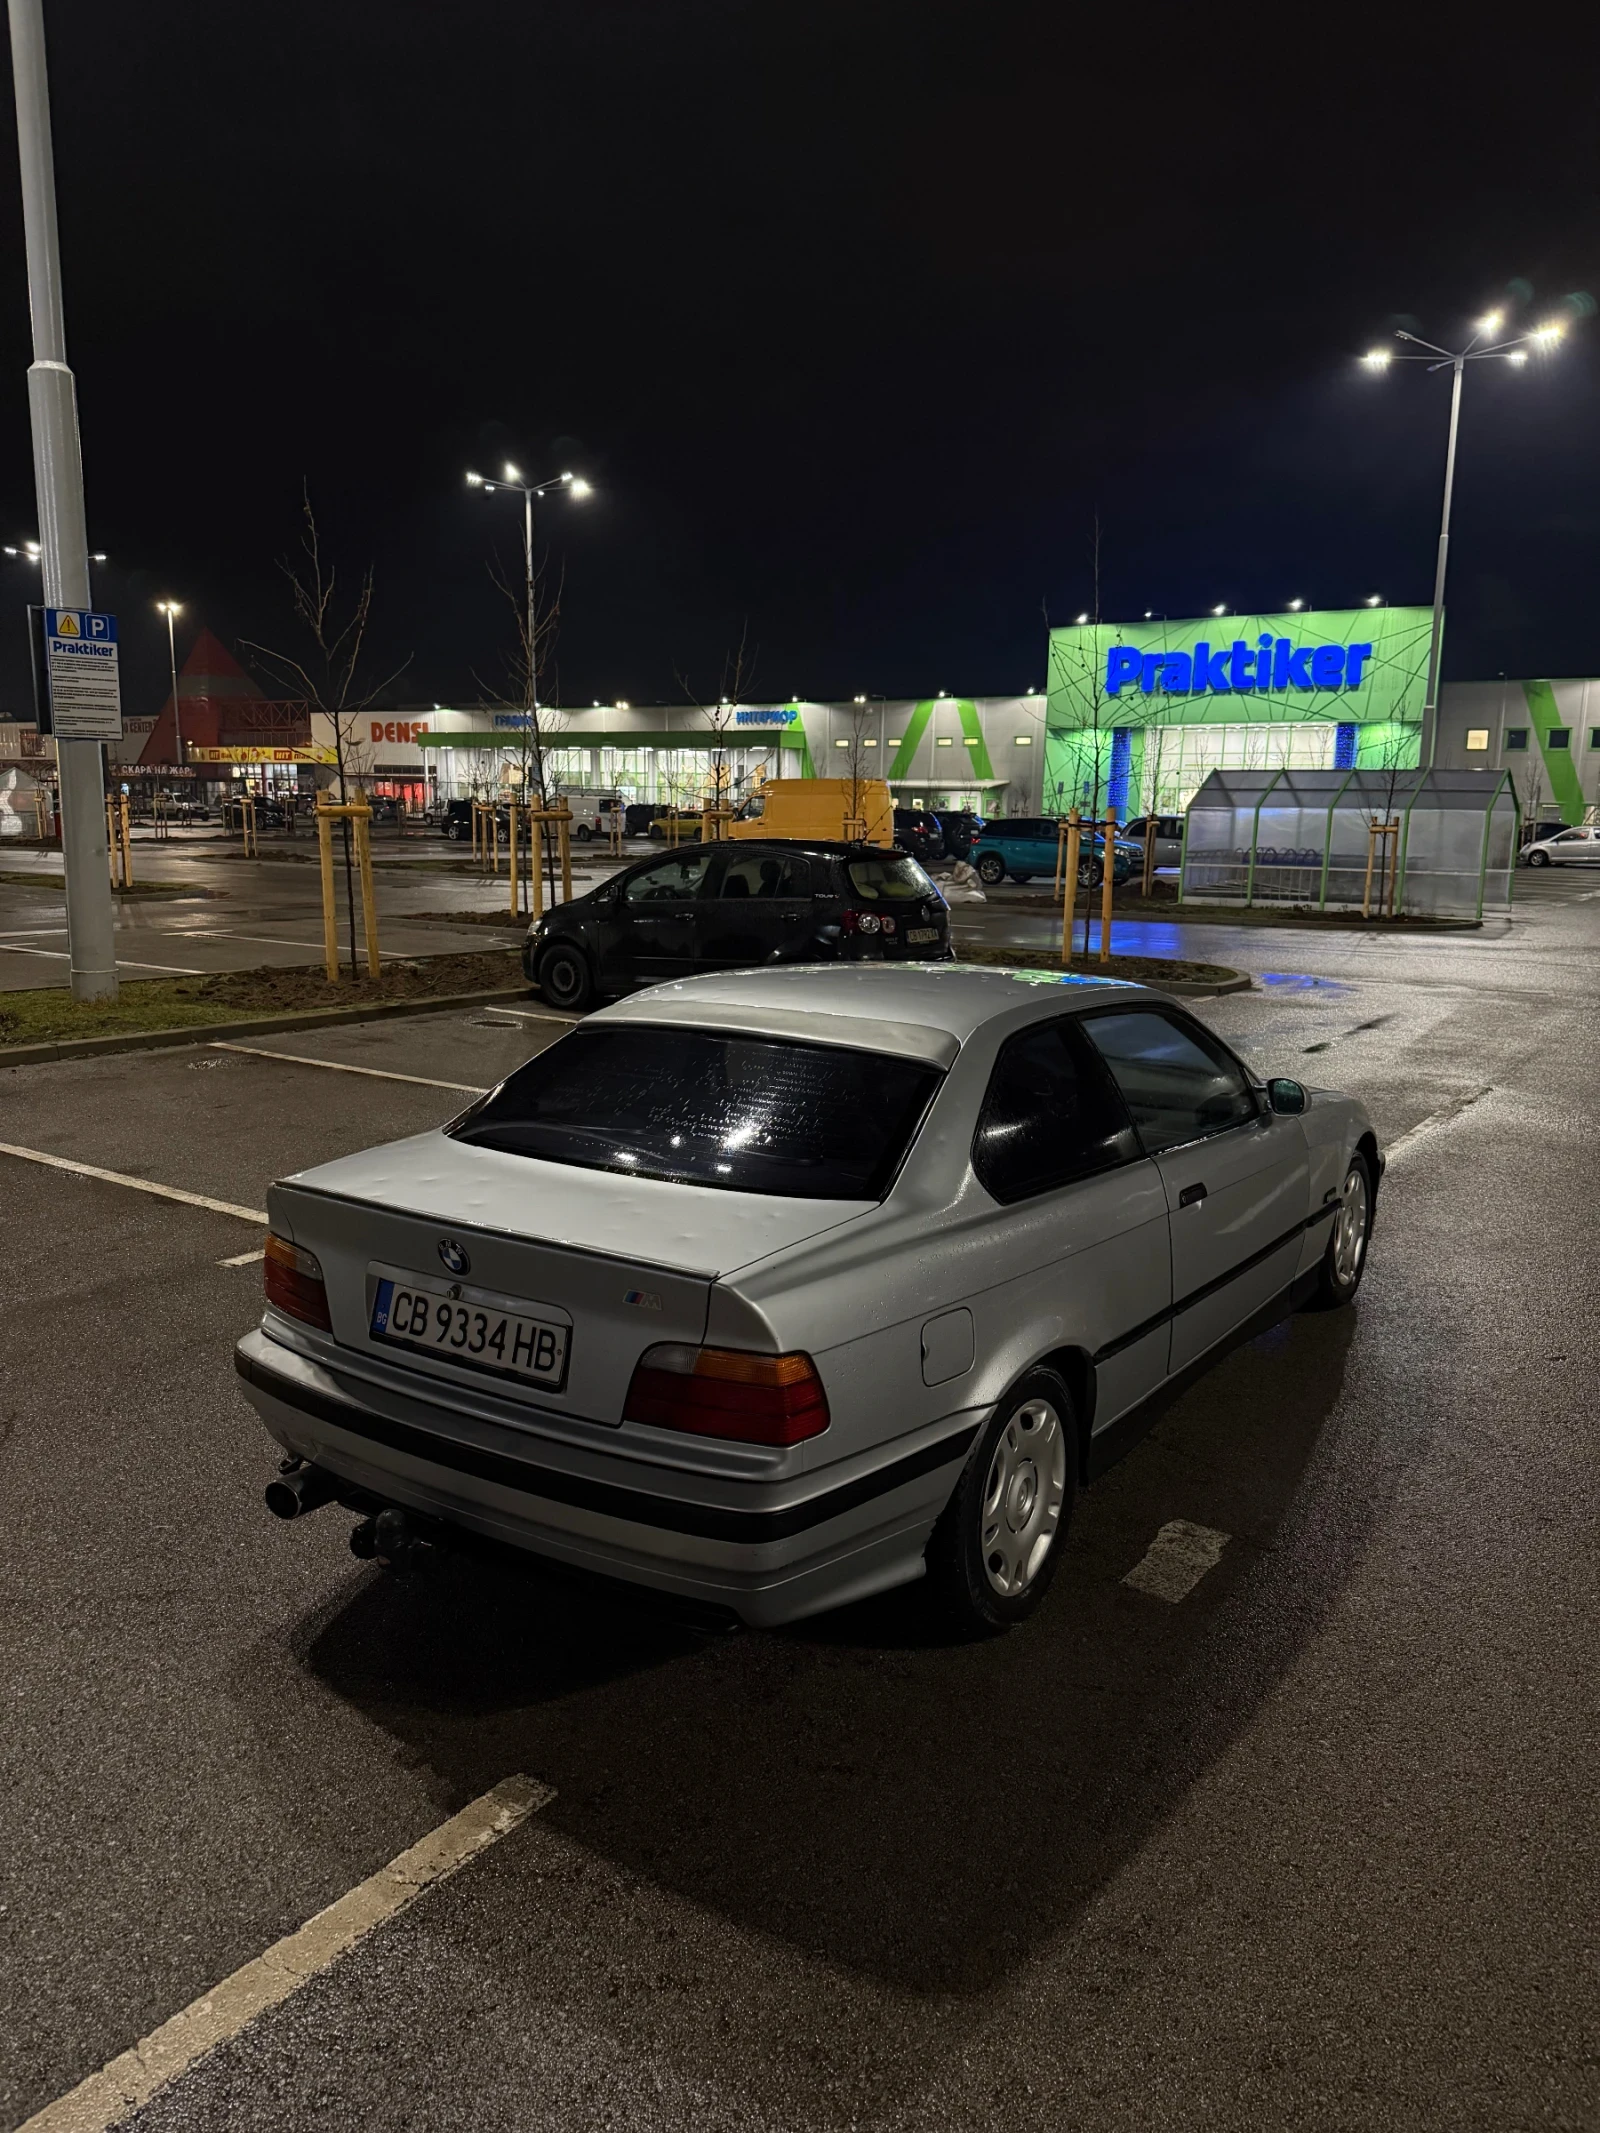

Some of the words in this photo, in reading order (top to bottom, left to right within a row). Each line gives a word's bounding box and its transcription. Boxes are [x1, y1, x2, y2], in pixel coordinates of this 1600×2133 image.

[92, 618, 104, 636] P
[53, 640, 113, 656] Praktiker
[1105, 632, 1372, 694] Praktiker
[736, 710, 798, 725] ИНТЕРИОР
[122, 764, 152, 774] СКАРА
[154, 765, 167, 775] НА
[438, 1240, 463, 1255] BMW
[376, 1311, 388, 1325] BG
[392, 1291, 430, 1337] CB
[436, 1303, 508, 1361] 9334
[511, 1323, 557, 1372] HB
